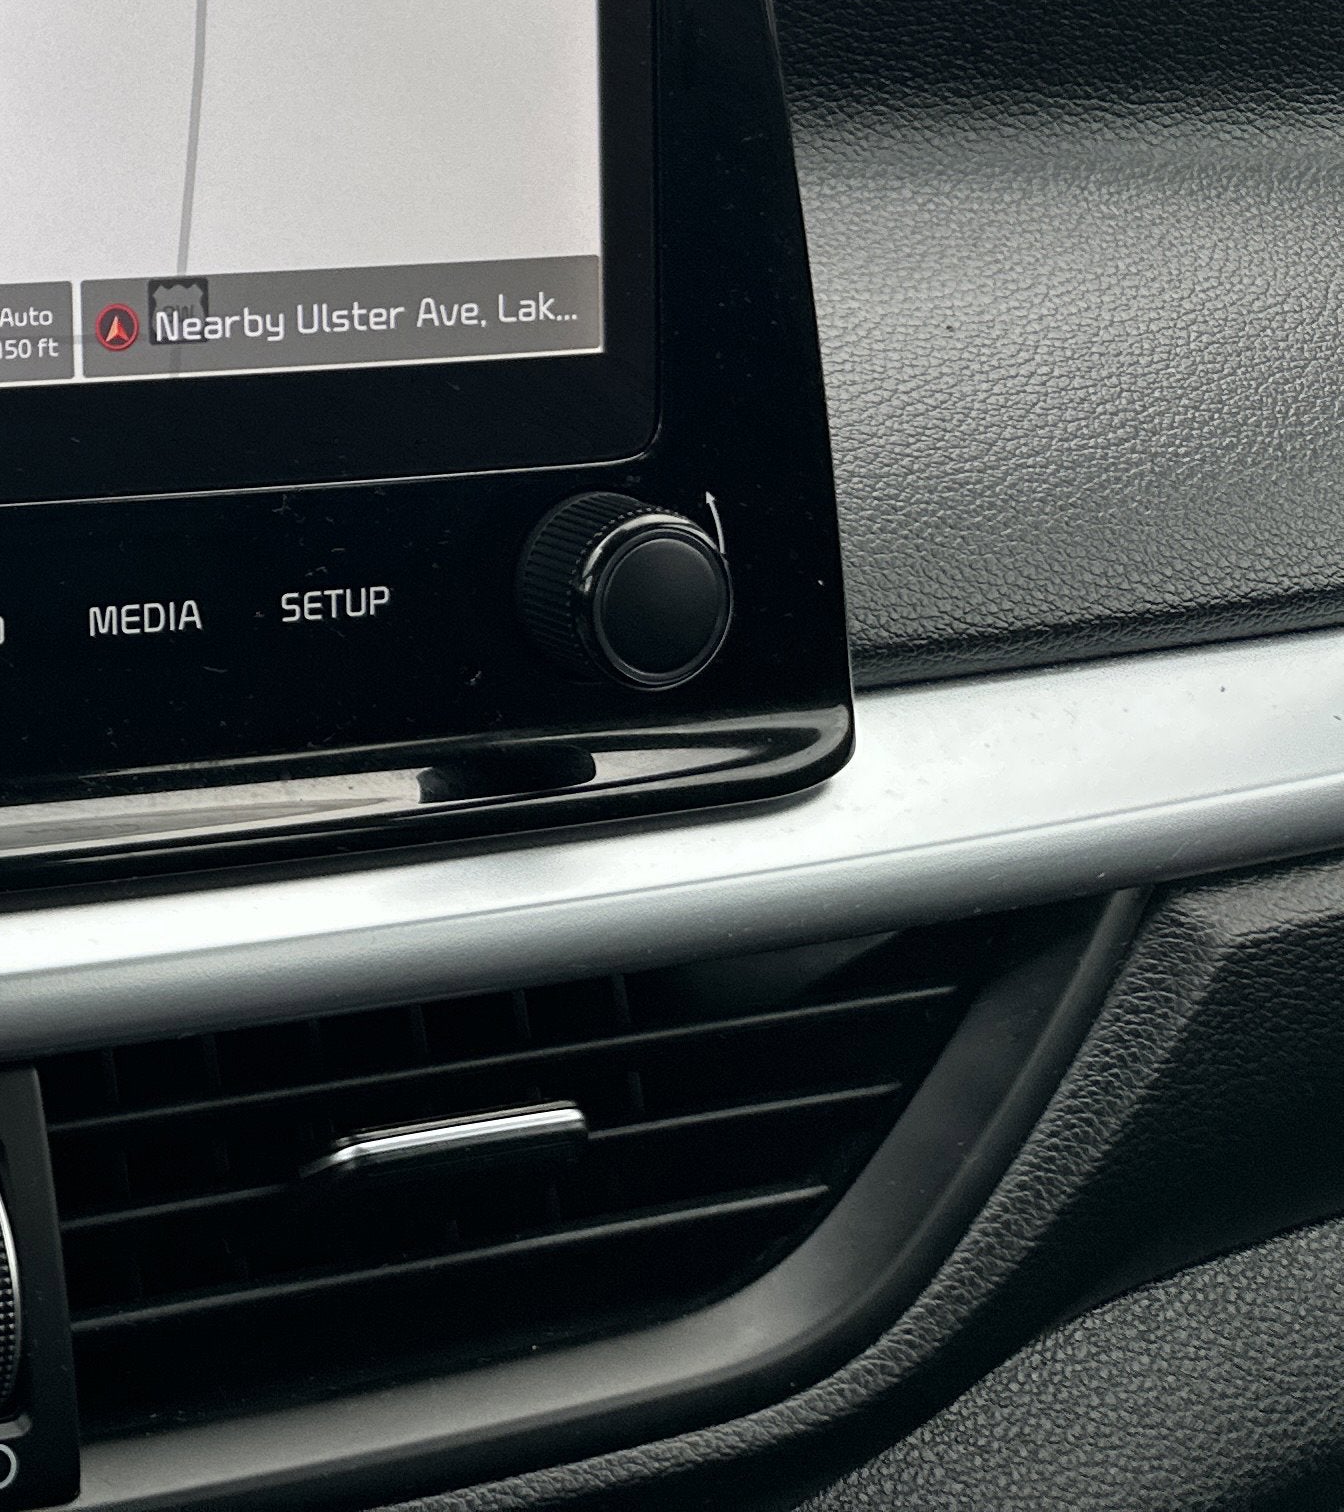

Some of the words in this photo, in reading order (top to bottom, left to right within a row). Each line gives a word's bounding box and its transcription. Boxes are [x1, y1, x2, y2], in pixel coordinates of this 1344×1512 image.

[155, 307, 286, 342] Nearby
[296, 301, 405, 335] Ulster
[416, 297, 487, 328] Ave,
[37, 337, 59, 358] ft
[89, 599, 202, 638] MEDIA
[281, 585, 391, 624] SETUP
